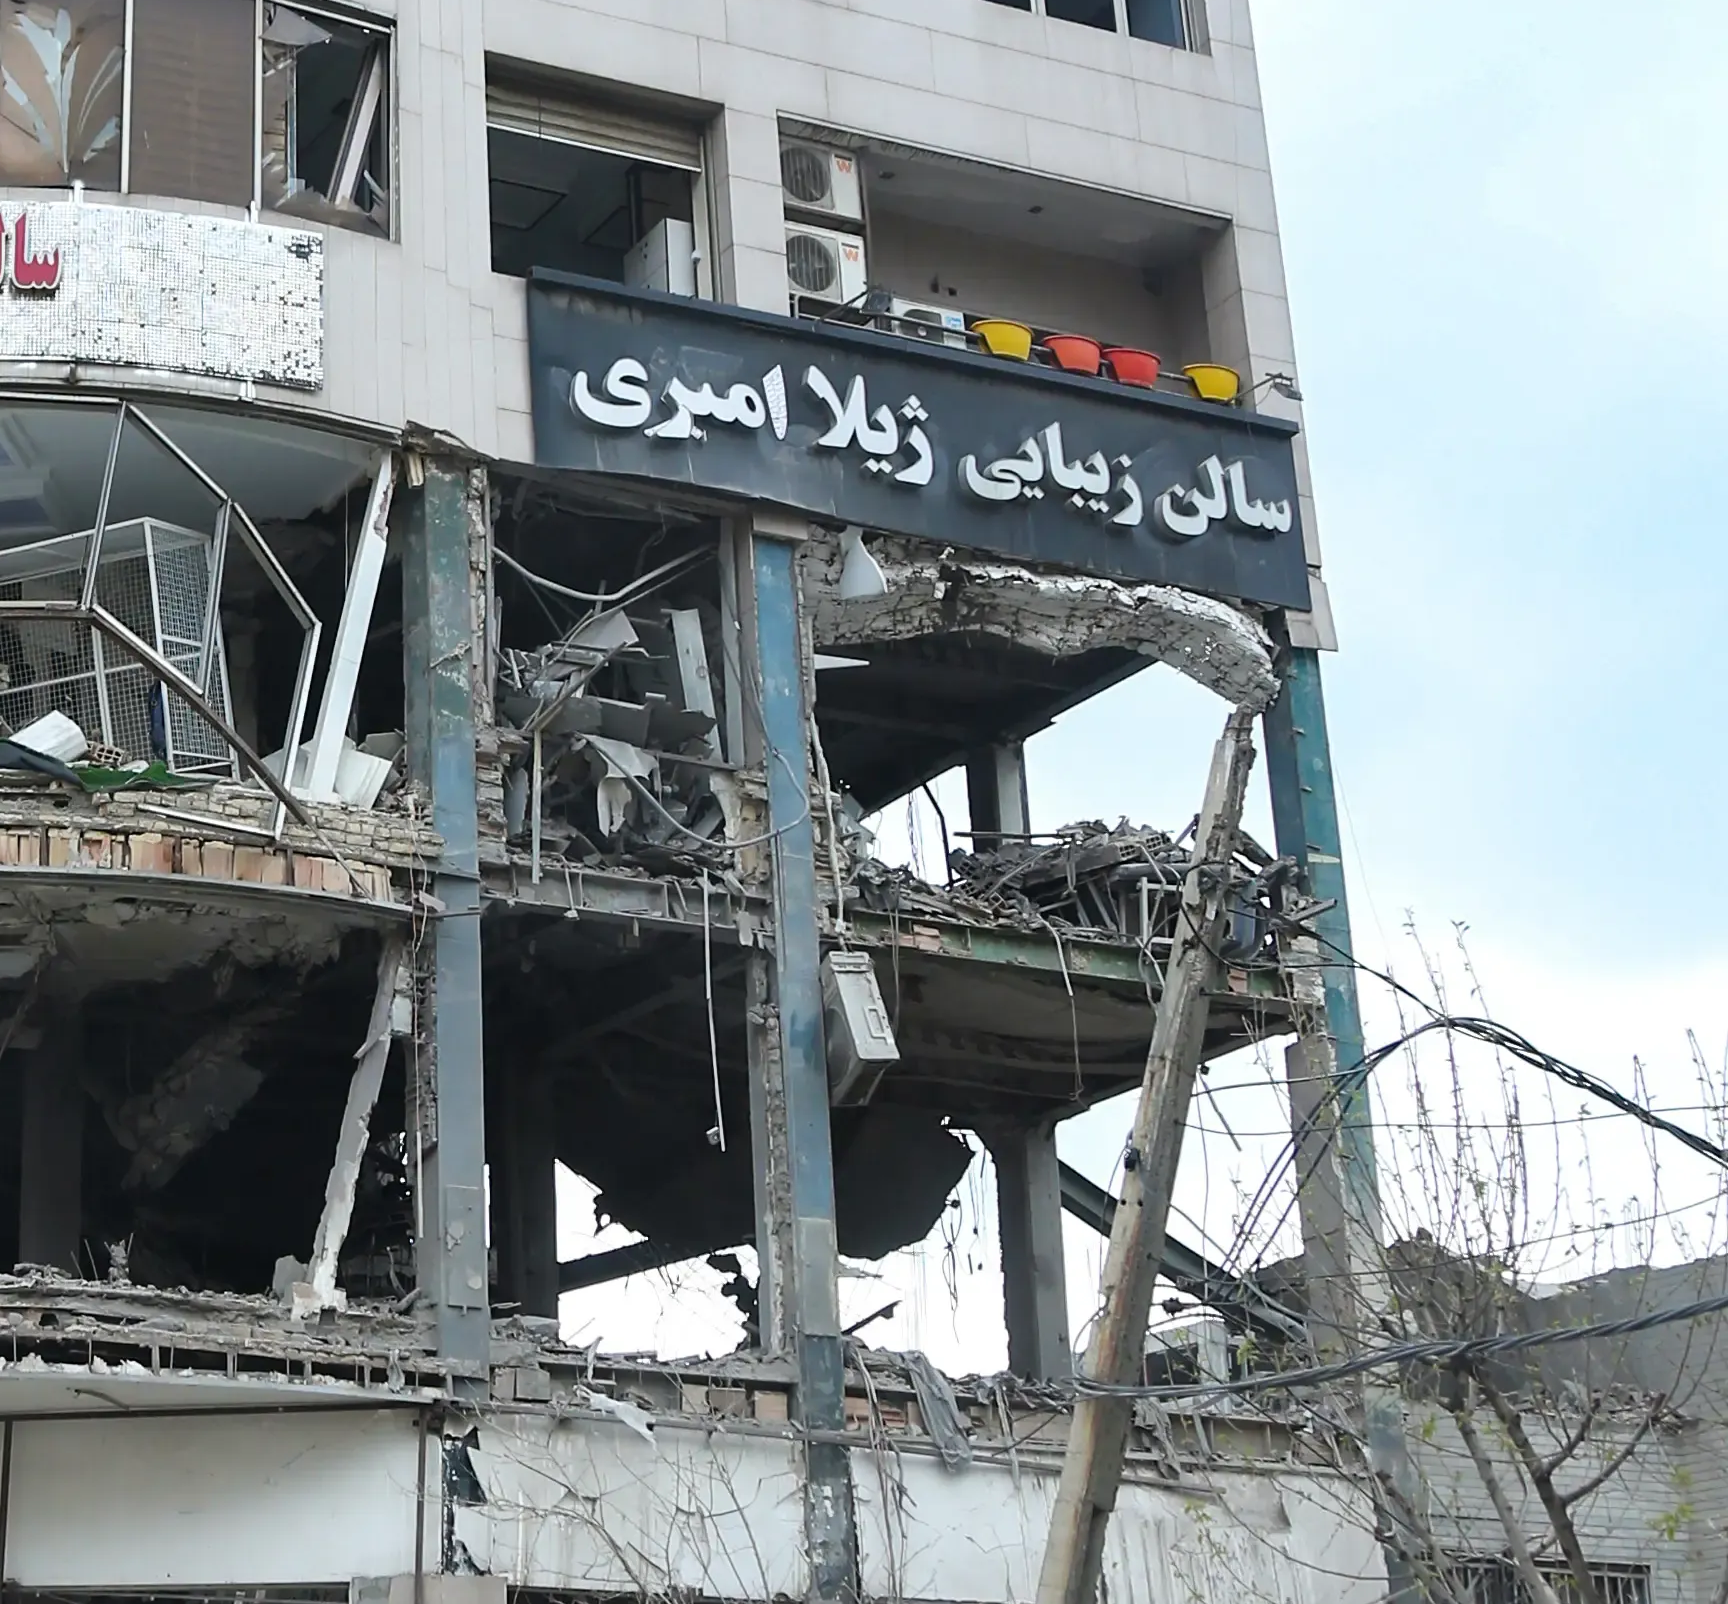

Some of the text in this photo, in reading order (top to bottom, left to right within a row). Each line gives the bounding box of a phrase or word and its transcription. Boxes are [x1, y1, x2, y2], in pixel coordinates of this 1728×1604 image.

[570, 355, 1293, 538] سالن زیبایی ژیلا امیری
